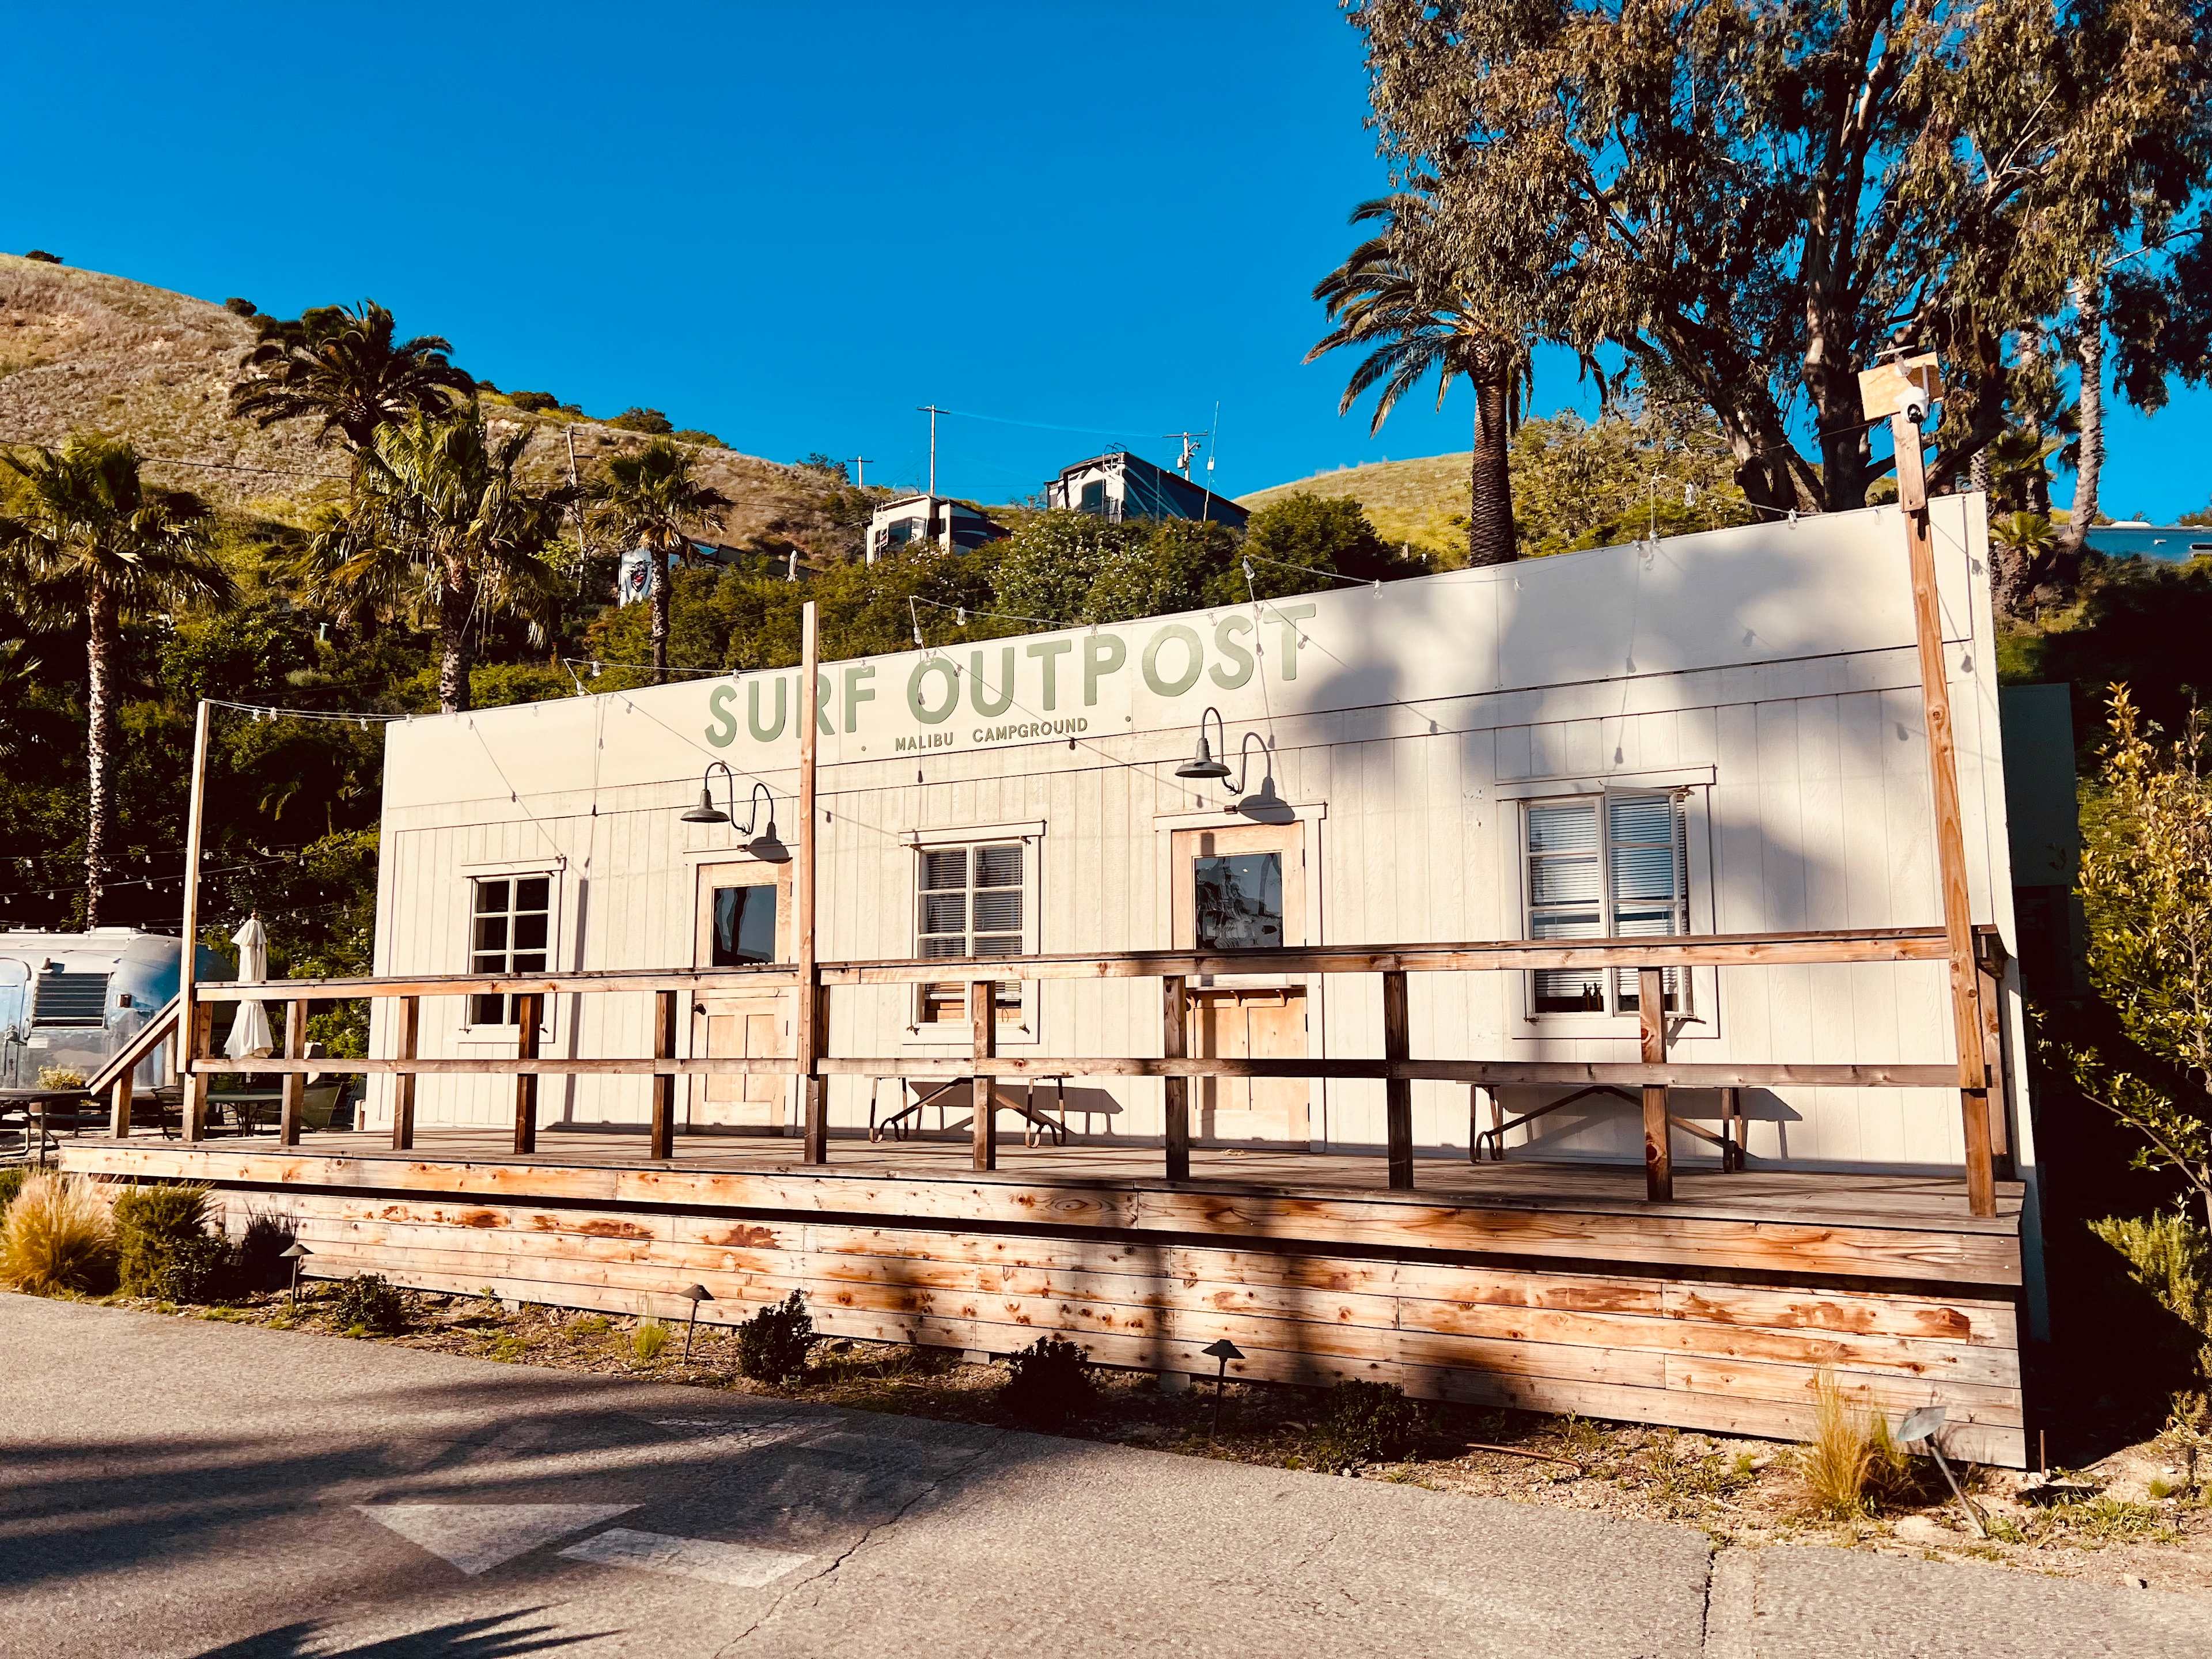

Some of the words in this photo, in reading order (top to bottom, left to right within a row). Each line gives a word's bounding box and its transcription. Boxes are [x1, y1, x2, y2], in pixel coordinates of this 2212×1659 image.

[704, 665, 875, 748] SURF
[906, 603, 1316, 725] OUTPOST
[895, 732, 954, 751] MALIBU
[972, 718, 1088, 743] CAMPGROUND
